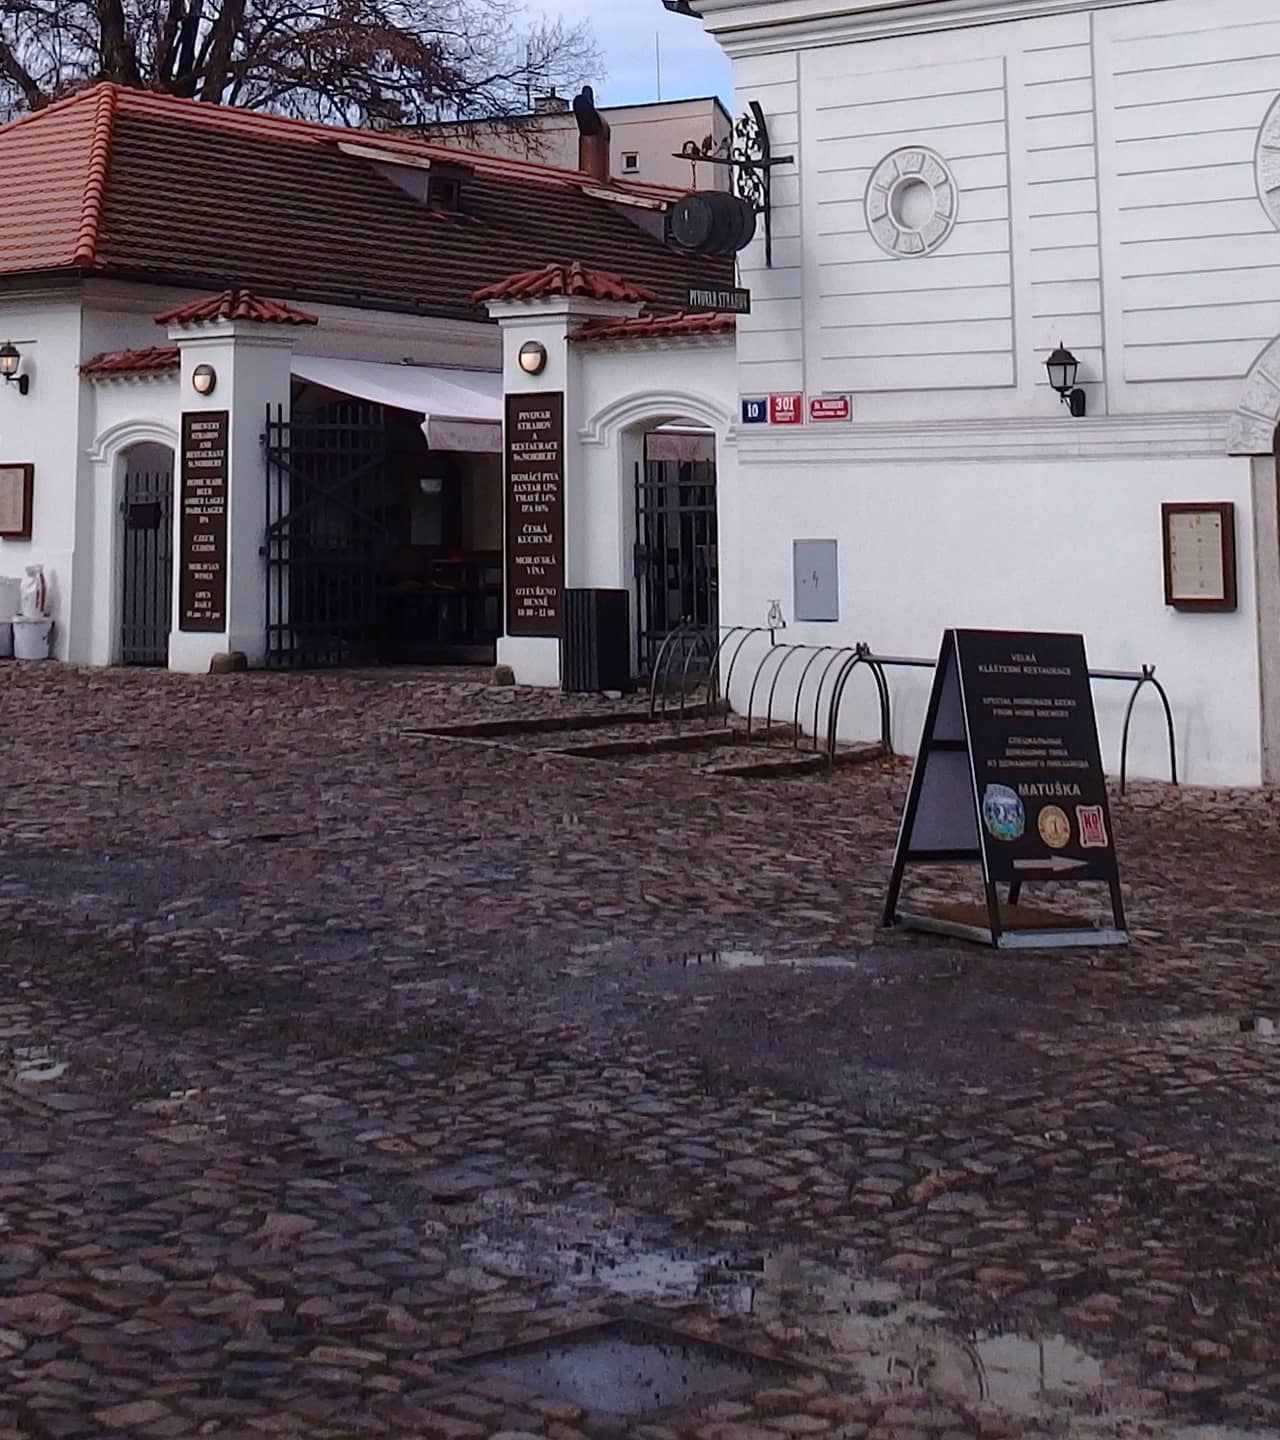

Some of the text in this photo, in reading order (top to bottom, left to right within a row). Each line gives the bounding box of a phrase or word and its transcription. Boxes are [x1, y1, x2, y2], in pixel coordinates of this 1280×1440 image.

[775, 397, 794, 411] 301
[518, 410, 551, 421] PIVOVAR
[747, 403, 759, 418] 10
[517, 421, 552, 431] STRAHOV
[511, 441, 558, 451] RESTAURACE
[511, 472, 559, 482] DOMÁCÍ PIVA
[513, 482, 541, 492] JANTAR
[515, 493, 540, 502] TMAVÉ
[521, 503, 534, 513] IPA
[522, 523, 548, 534] ČESKÁ
[517, 534, 553, 544] KUCHYNĚ
[515, 554, 557, 565] MORAVSKÁ
[526, 564, 545, 575] VÍNA
[515, 585, 557, 596] OTEVŘENO
[523, 595, 548, 606] DENNĚ
[1018, 781, 1081, 796] MATUŠKA
